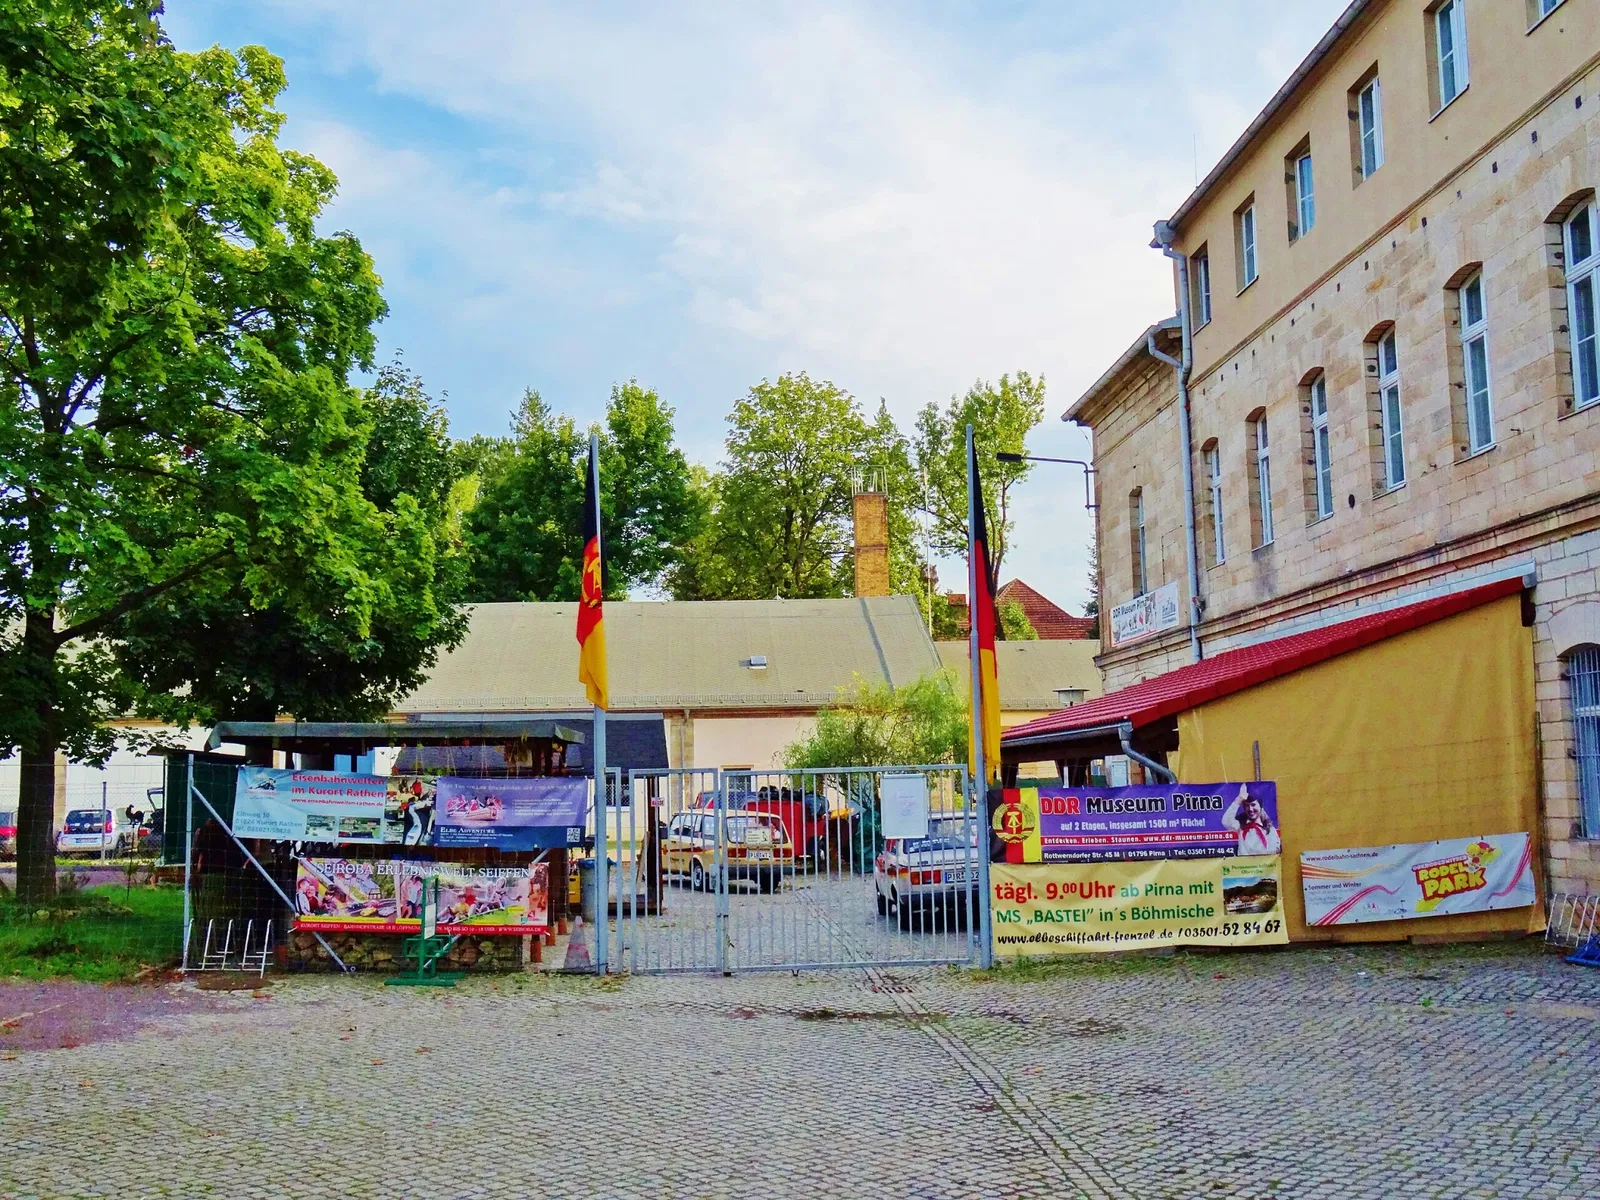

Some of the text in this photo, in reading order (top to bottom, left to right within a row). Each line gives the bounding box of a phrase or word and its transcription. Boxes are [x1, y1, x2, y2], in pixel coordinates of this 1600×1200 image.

[292, 773, 385, 785] Eisenbahnwelten
[308, 786, 343, 796] Kurort
[346, 788, 385, 798] Rathen
[1040, 792, 1224, 815] DDR Museum Pirna
[1060, 821, 1072, 831] auf
[1074, 821, 1080, 831] 2
[1081, 821, 1108, 832] Etagen,
[1109, 820, 1147, 831] insgesamt
[1148, 819, 1167, 828] 1500
[1081, 836, 1109, 844] Erleben.
[1143, 832, 1234, 842] www.ddr-museum-pirna.de
[1044, 851, 1090, 859] Rottwerndorfer
[1226, 846, 1234, 854] 42
[1306, 852, 1378, 862] www.rodelbahn-sachsen.de
[316, 863, 531, 878] SEIROBA ERLEBNISWELT SEIFFEN
[1418, 861, 1466, 881] RODEL
[1424, 870, 1485, 898] PARK
[994, 882, 1038, 904] tägl.
[1080, 880, 1116, 900] Uhr
[1120, 883, 1140, 898] ab
[1144, 882, 1184, 897] Pirna
[1188, 880, 1214, 896] mit
[996, 909, 1022, 923] MS
[1131, 904, 1214, 921] Böhmische
[1243, 921, 1261, 935] 84
[1264, 920, 1281, 934] 67
